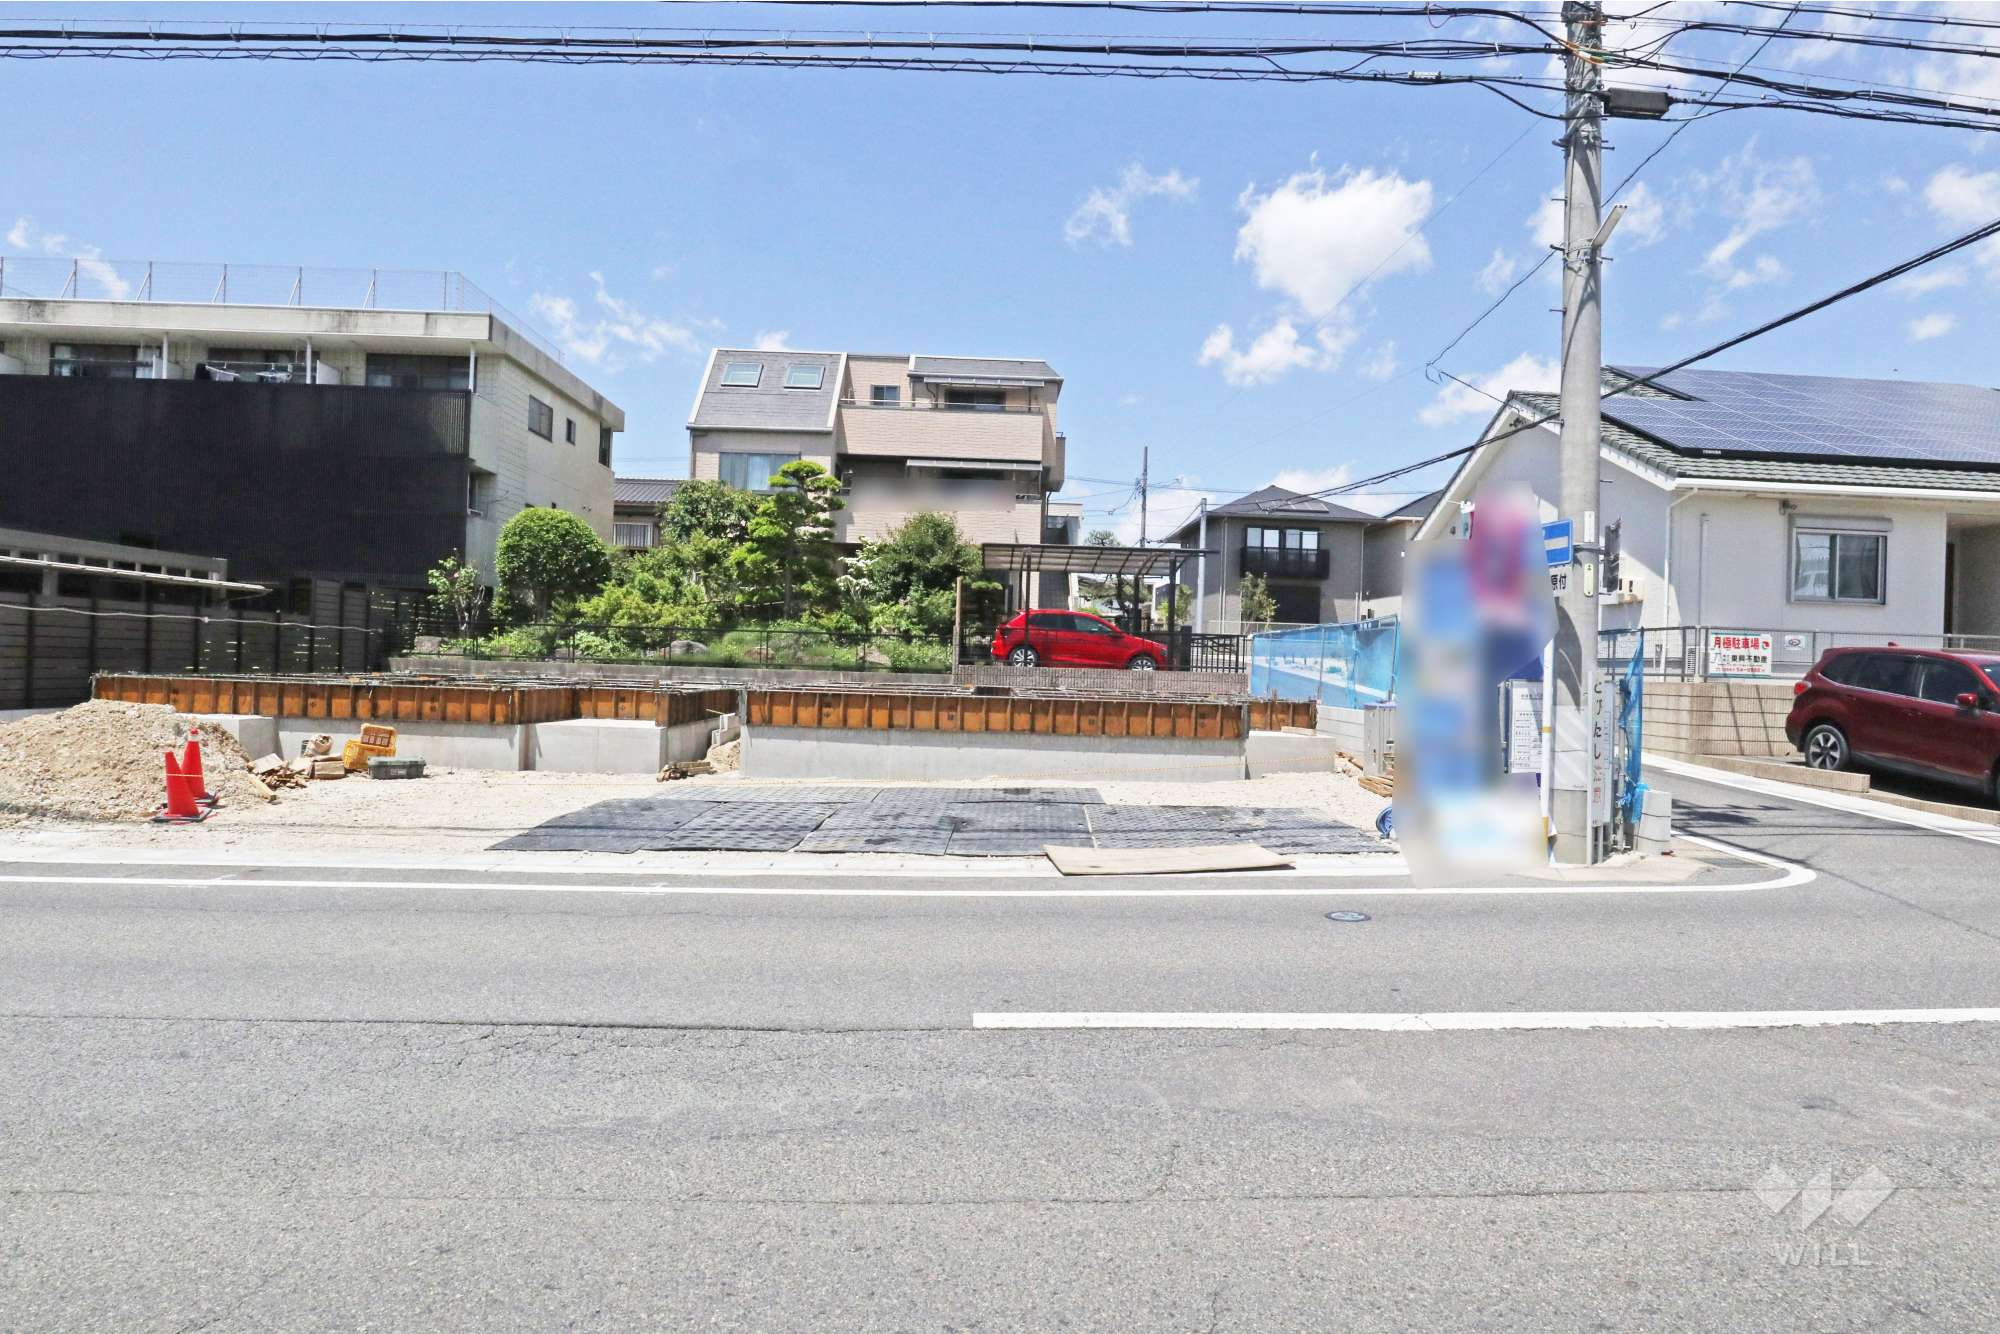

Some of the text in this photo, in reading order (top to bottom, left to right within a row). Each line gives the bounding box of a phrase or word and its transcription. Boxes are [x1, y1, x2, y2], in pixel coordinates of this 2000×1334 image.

[1713, 636, 1760, 649] 月極駐車場
